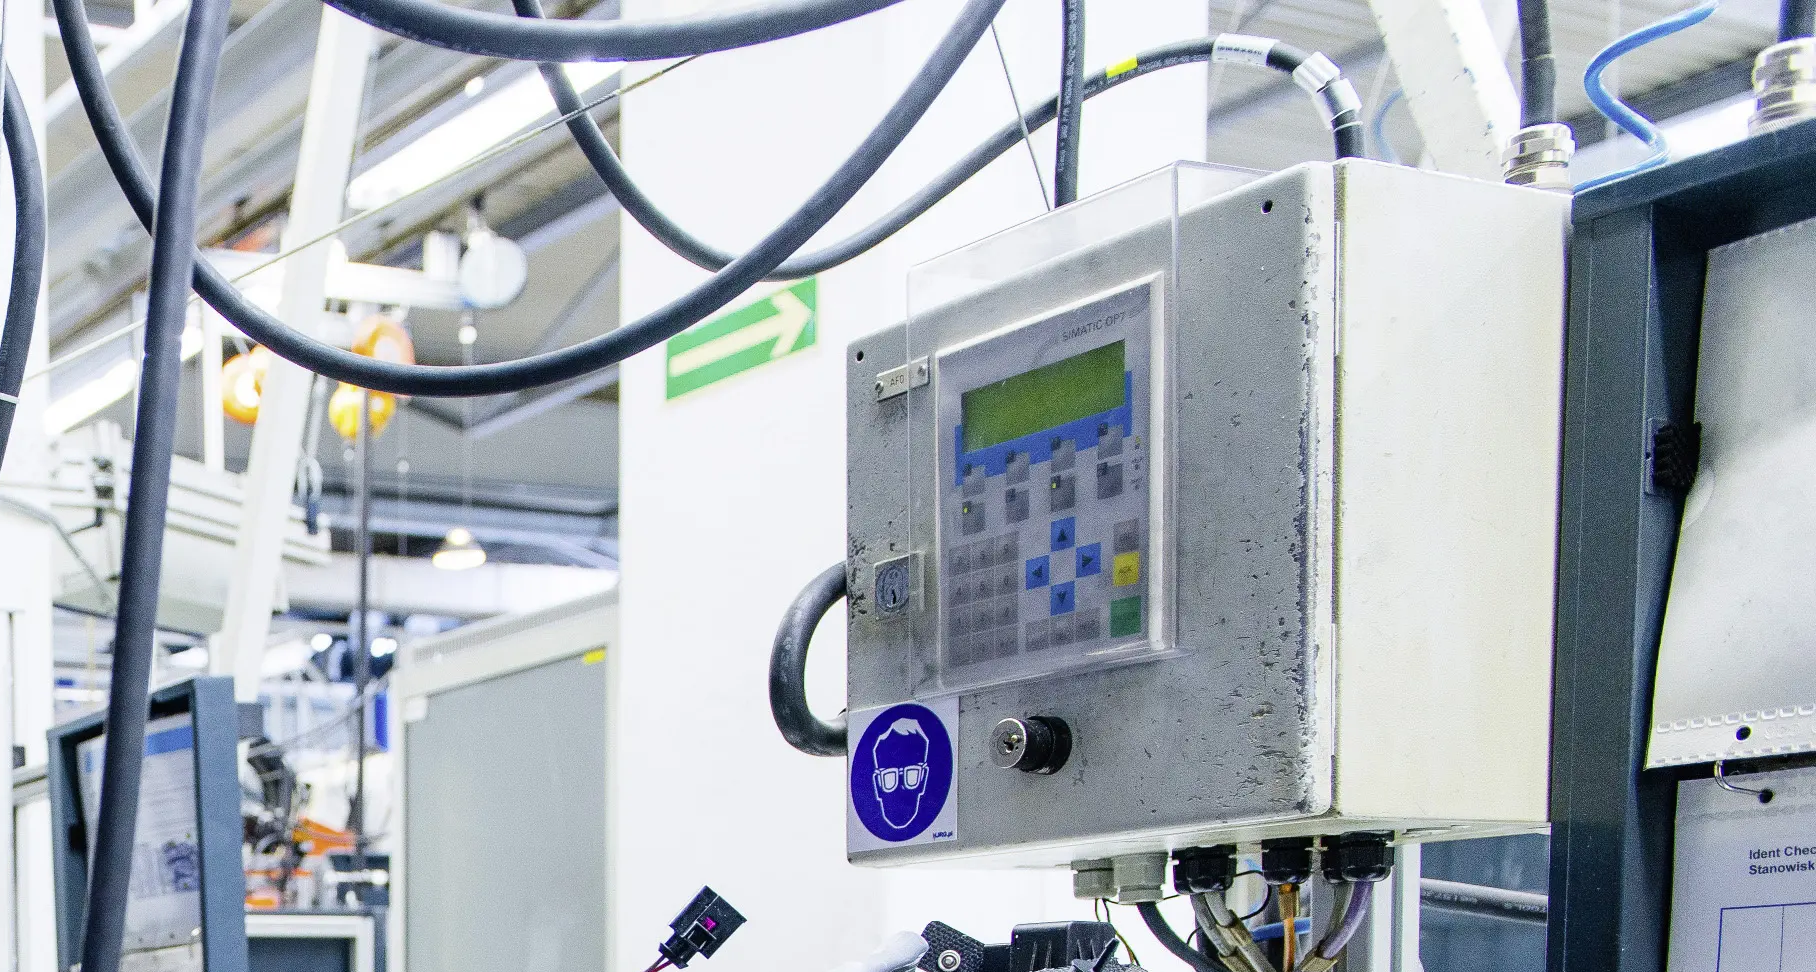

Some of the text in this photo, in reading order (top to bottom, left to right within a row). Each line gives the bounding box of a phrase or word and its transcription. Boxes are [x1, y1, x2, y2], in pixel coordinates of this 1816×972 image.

[1063, 311, 1125, 341] SIMATIC OP7
[1749, 846, 1816, 860] Ident Chec
[1749, 860, 1815, 875] Stanowisk
